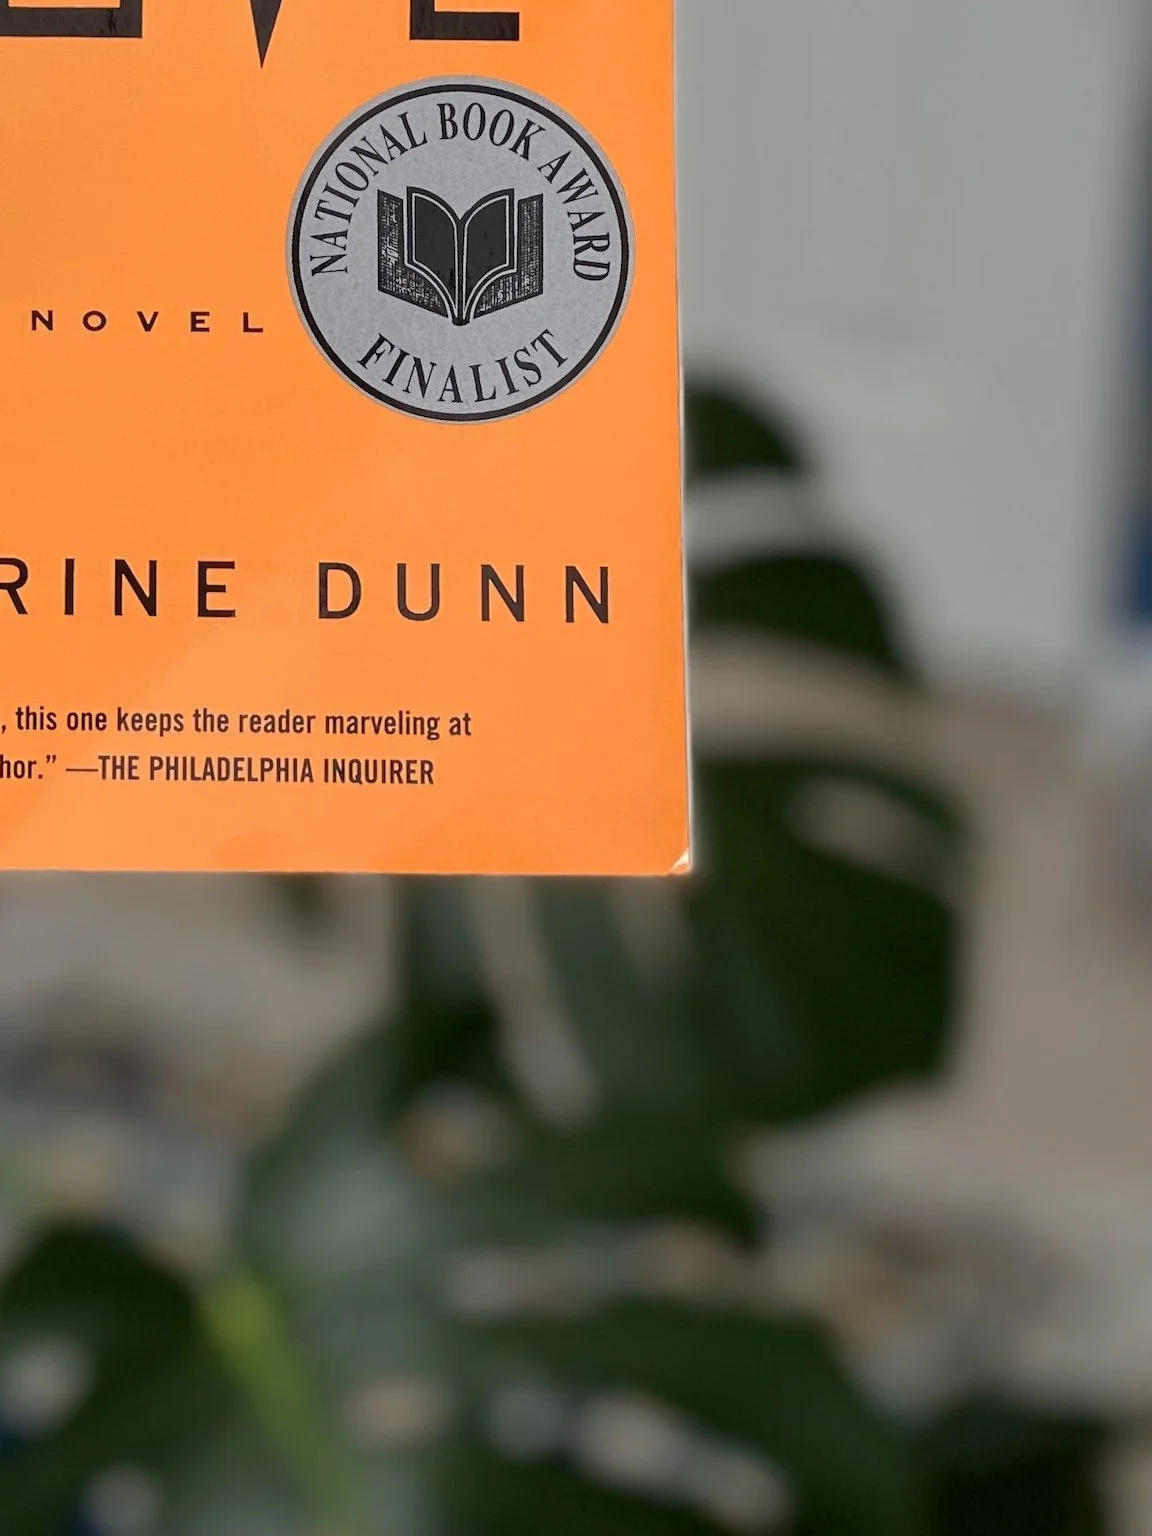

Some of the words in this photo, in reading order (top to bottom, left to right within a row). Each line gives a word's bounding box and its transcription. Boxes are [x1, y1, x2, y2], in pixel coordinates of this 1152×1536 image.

[309, 112, 428, 276] NATIONAL
[436, 102, 546, 161] BOOK
[537, 150, 611, 282] AWARD
[31, 311, 264, 333] NOVEL
[356, 328, 569, 403] FINALIST
[318, 562, 609, 624] DUNN
[15, 705, 57, 731] this
[67, 712, 107, 732] one
[117, 706, 184, 737] keeps
[192, 707, 229, 734] the
[239, 708, 316, 735] reader
[325, 710, 440, 742] marveling
[449, 712, 472, 737] at
[149, 756, 314, 784] PHILADELPHIA
[324, 758, 434, 786] INQUIRER
